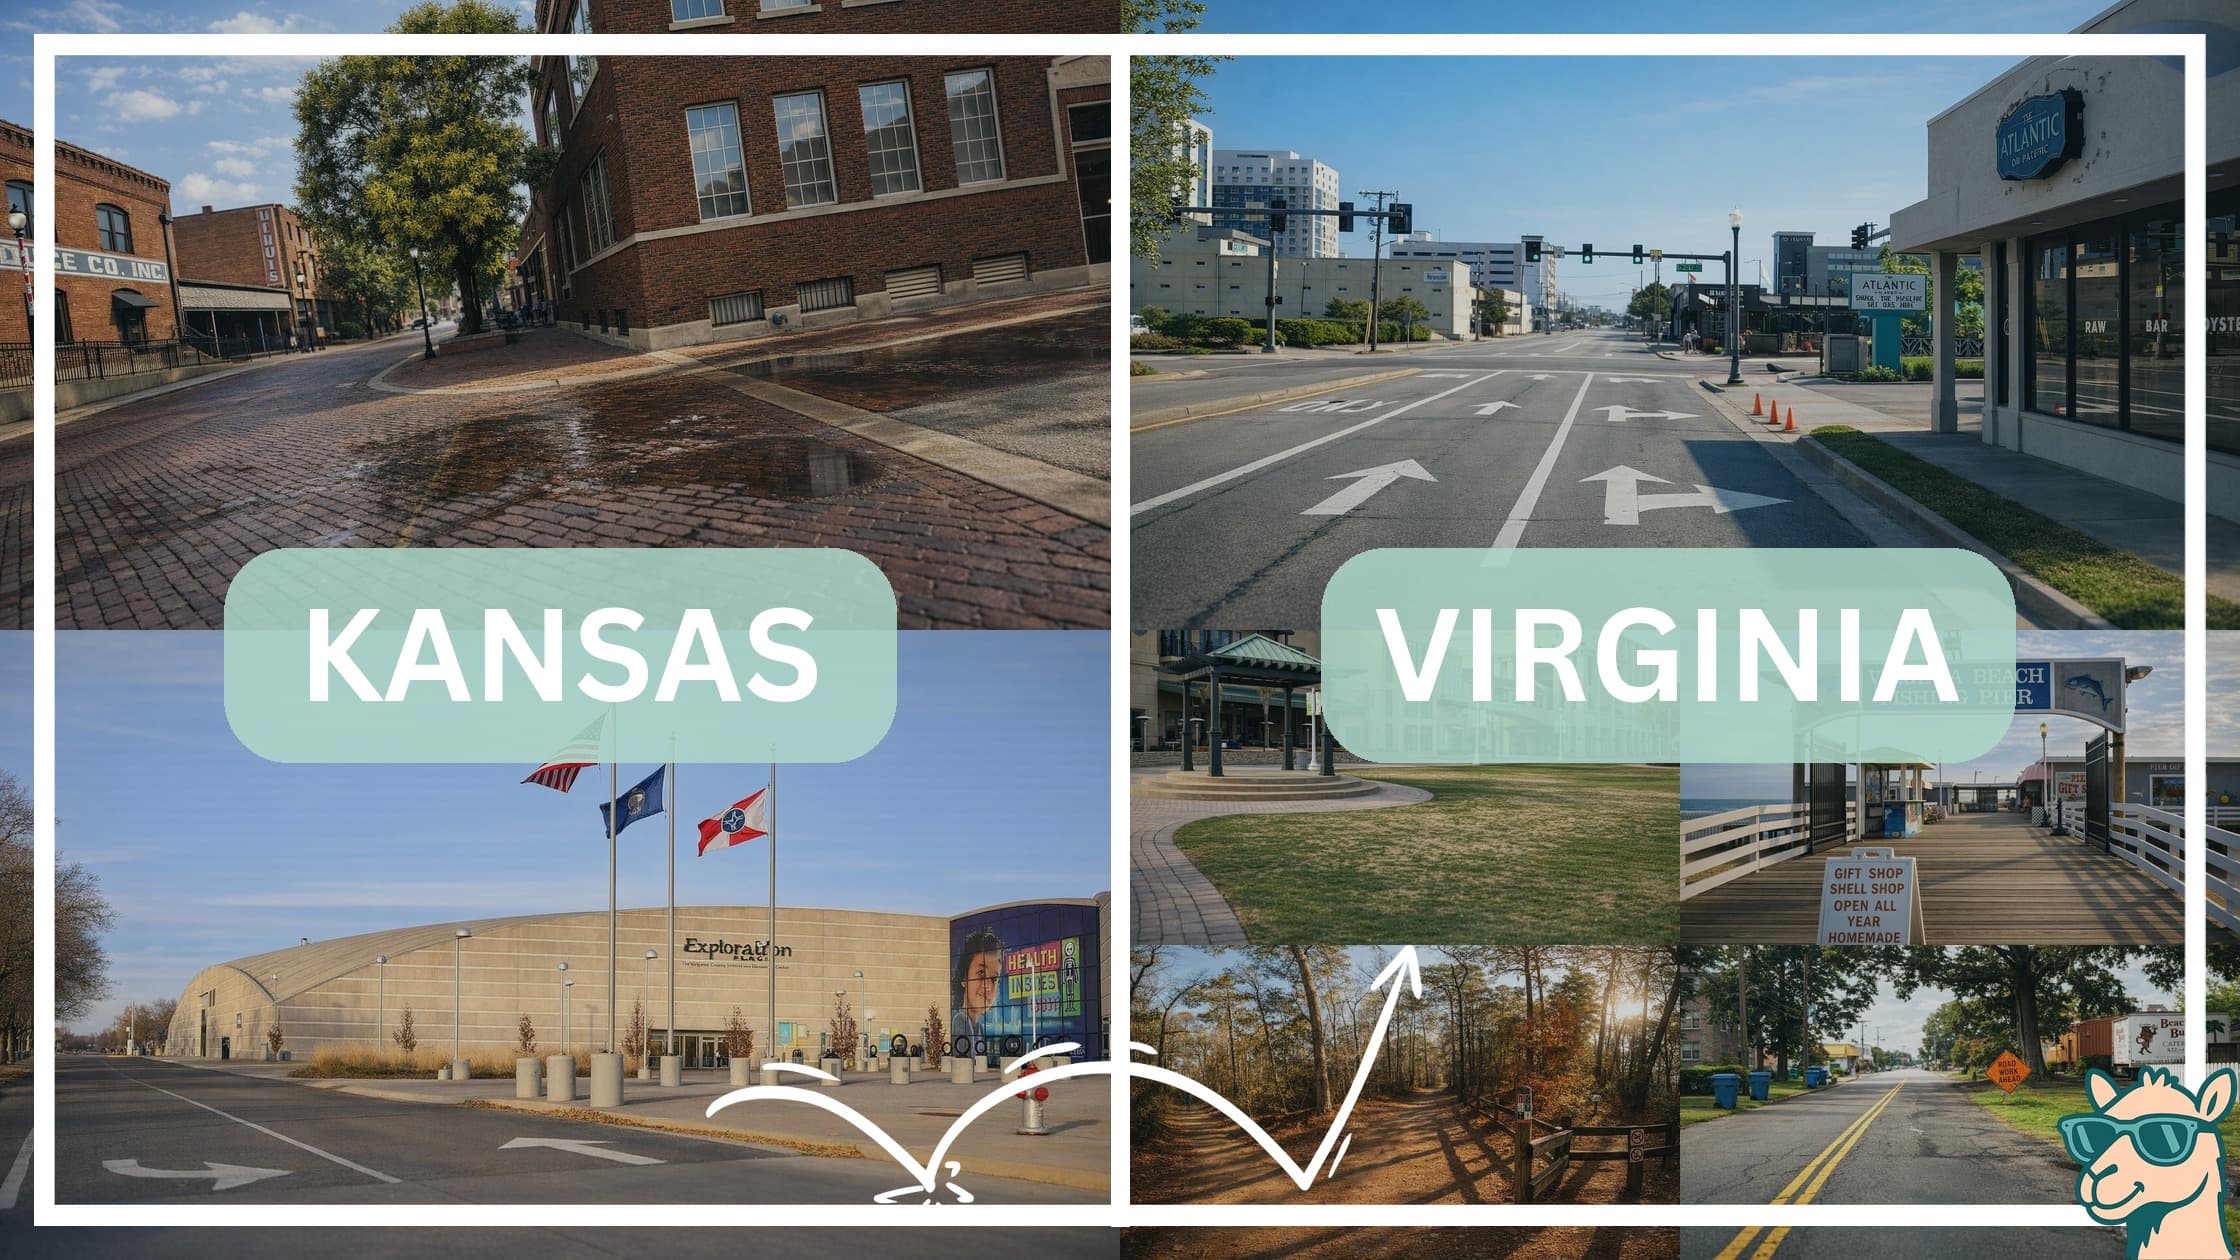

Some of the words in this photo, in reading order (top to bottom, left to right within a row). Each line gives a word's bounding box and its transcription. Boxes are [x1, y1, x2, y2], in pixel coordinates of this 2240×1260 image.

[2000, 112, 2060, 159] ATLANTIC
[87, 255, 125, 276] CO.
[131, 261, 167, 281] INC.
[1862, 280, 1917, 291] ATLANTIC
[2084, 320, 2107, 334] RAW
[2145, 319, 2168, 333] BAR
[2058, 782, 2079, 794] GIFT
[1834, 868, 1862, 879] GIFT
[1868, 868, 1904, 879] SHOP
[1830, 883, 1867, 895] SHELL
[1871, 883, 1905, 895] SHOP
[1833, 900, 1869, 912] OPEN
[1874, 900, 1897, 912] ALL
[1847, 916, 1881, 927] YEAR
[1828, 932, 1901, 944] HOMEMADE
[1008, 948, 1057, 971] HEALTH
[2160, 1018, 2185, 1029] Beac
[1998, 1060, 2017, 1068] ROAD
[1999, 1068, 2019, 1076] WORK
[1998, 1075, 2021, 1083] AHEAD
